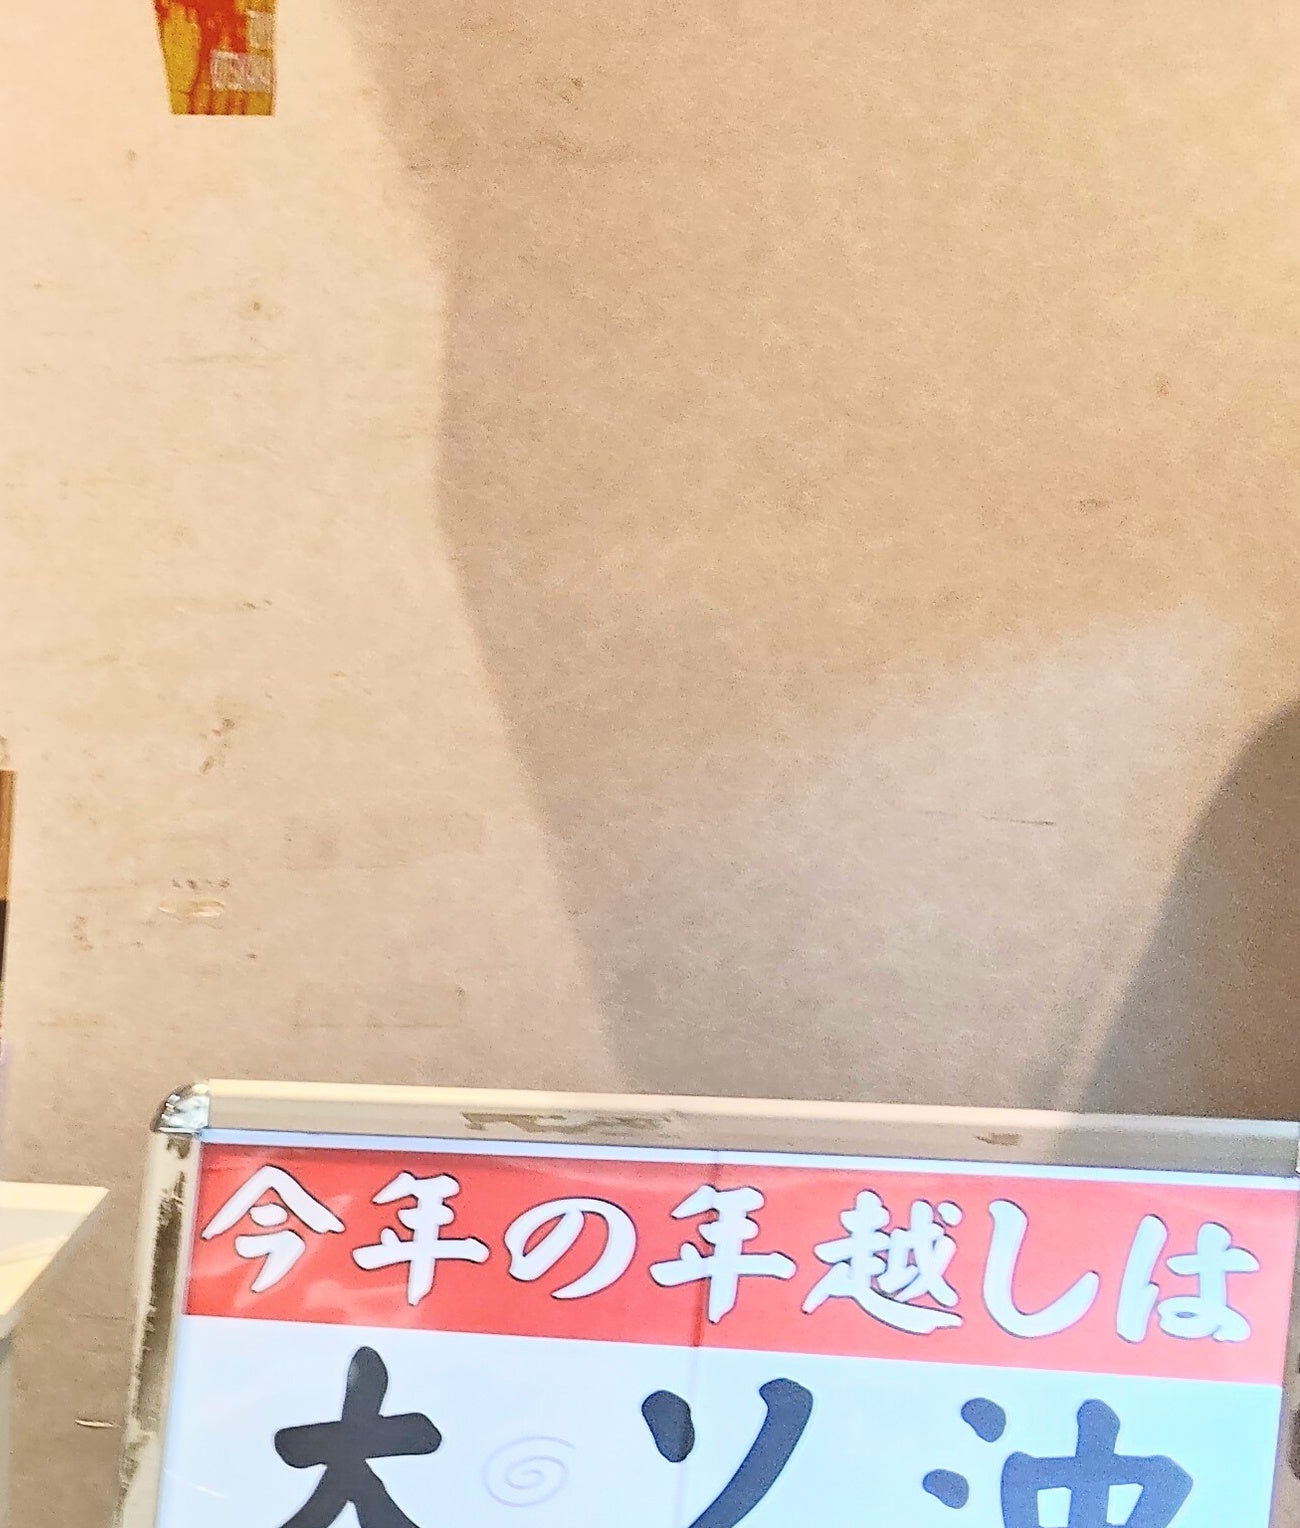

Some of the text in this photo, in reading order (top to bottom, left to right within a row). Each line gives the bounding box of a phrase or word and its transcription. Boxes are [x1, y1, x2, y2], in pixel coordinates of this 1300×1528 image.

[200, 1164, 1264, 1346] 今年の年越しは
